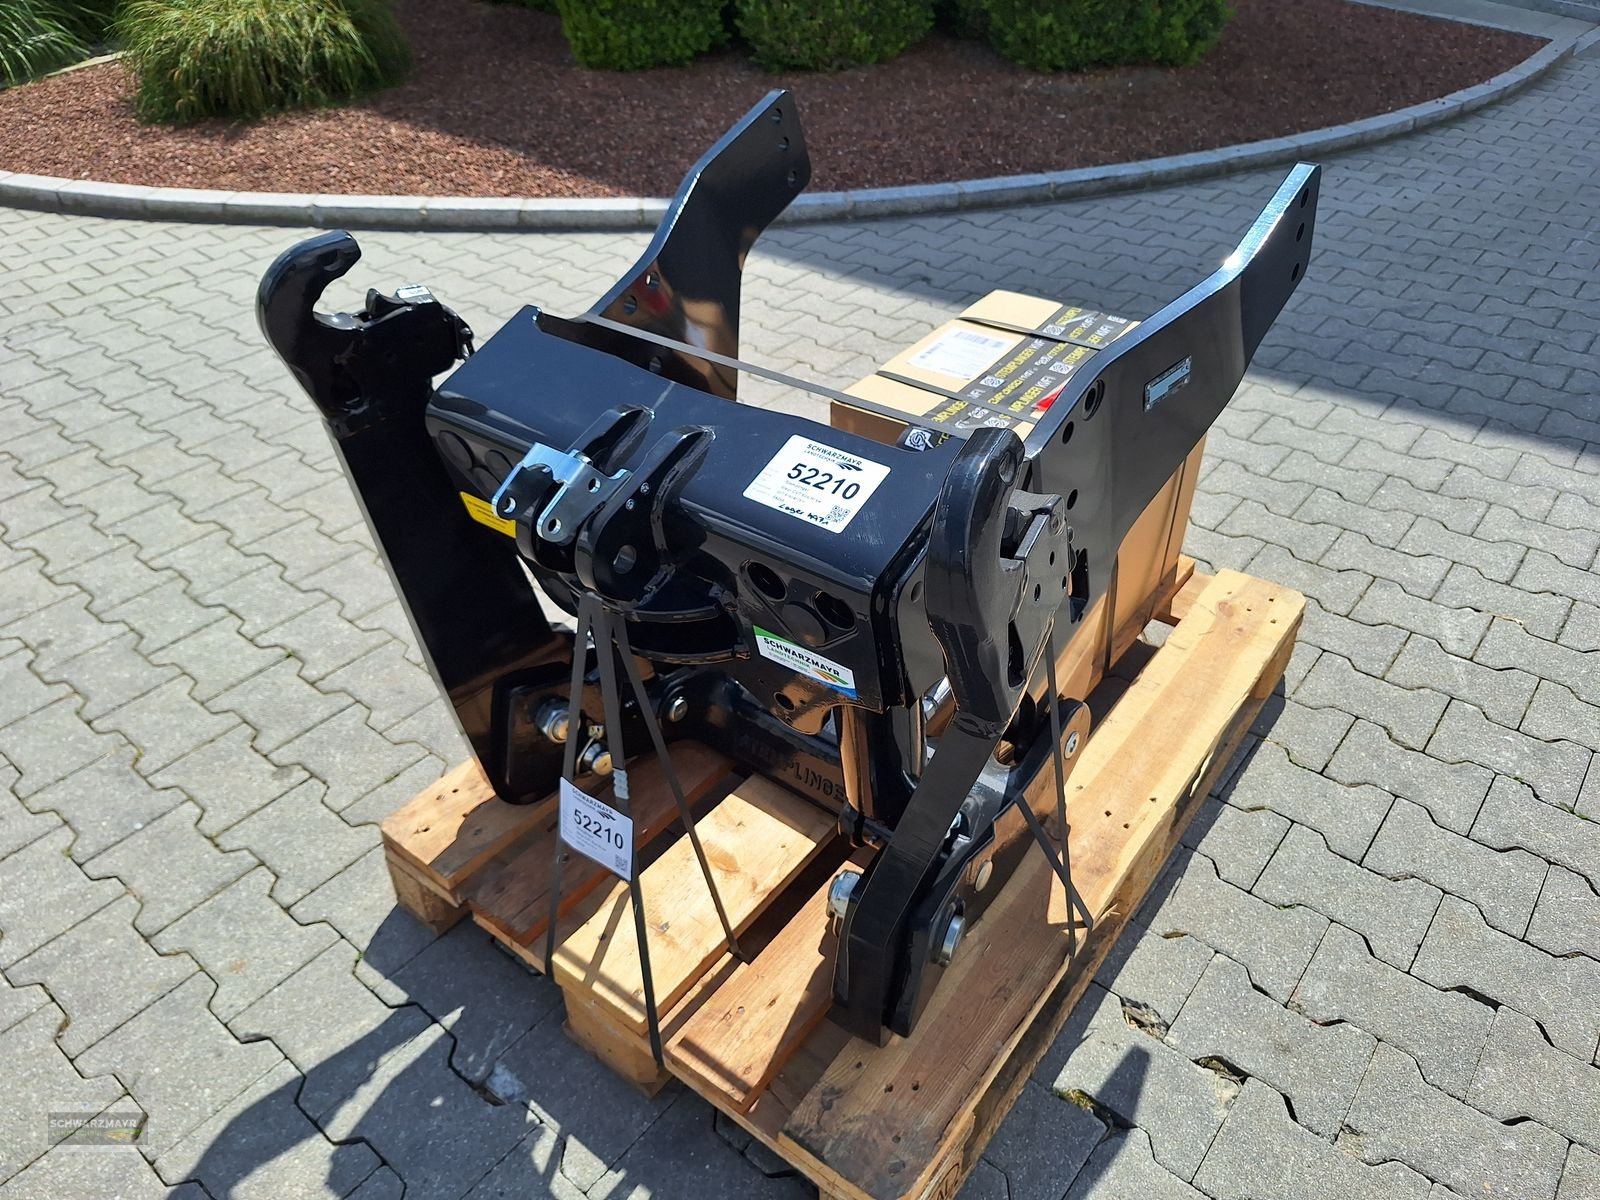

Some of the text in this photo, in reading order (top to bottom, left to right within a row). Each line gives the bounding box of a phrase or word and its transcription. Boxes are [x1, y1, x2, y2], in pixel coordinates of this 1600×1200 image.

[806, 443, 863, 466] SCHWARZMAYR
[787, 462, 861, 500] 52210
[763, 637, 841, 677] SCHWARZMAYR
[571, 788, 614, 814] SCHWARZMAYR
[573, 808, 624, 849] 52210
